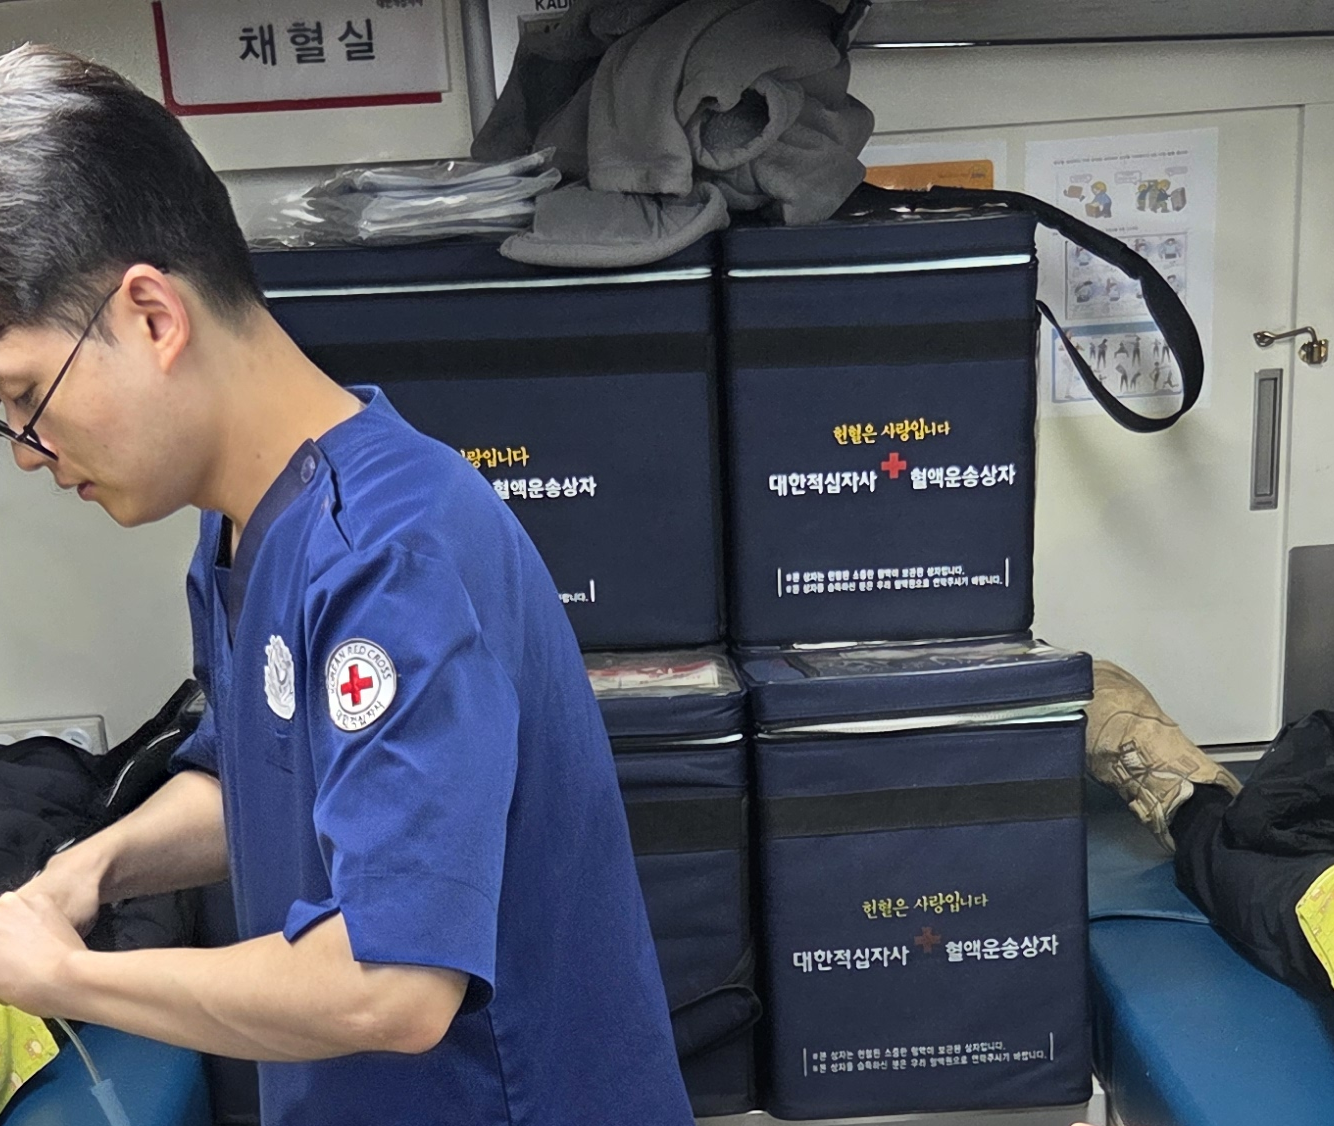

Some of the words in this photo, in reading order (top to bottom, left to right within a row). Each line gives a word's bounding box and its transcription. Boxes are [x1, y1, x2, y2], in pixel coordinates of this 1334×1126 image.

[238, 18, 376, 66] 채혈실
[833, 423, 878, 445] 헌혈은
[880, 418, 951, 442] 사랑입니다
[492, 475, 598, 500] 혈액운송상자
[768, 470, 878, 497] 대한적십자사
[910, 462, 1017, 490] 혈액운송상자
[347, 644, 367, 656] RED
[367, 649, 392, 680] CROSS
[862, 897, 909, 920] 헌혈은
[913, 890, 989, 914] 사랑입니다
[793, 945, 910, 973] 대한적십자사
[945, 934, 1059, 963] 혈액운송상자
